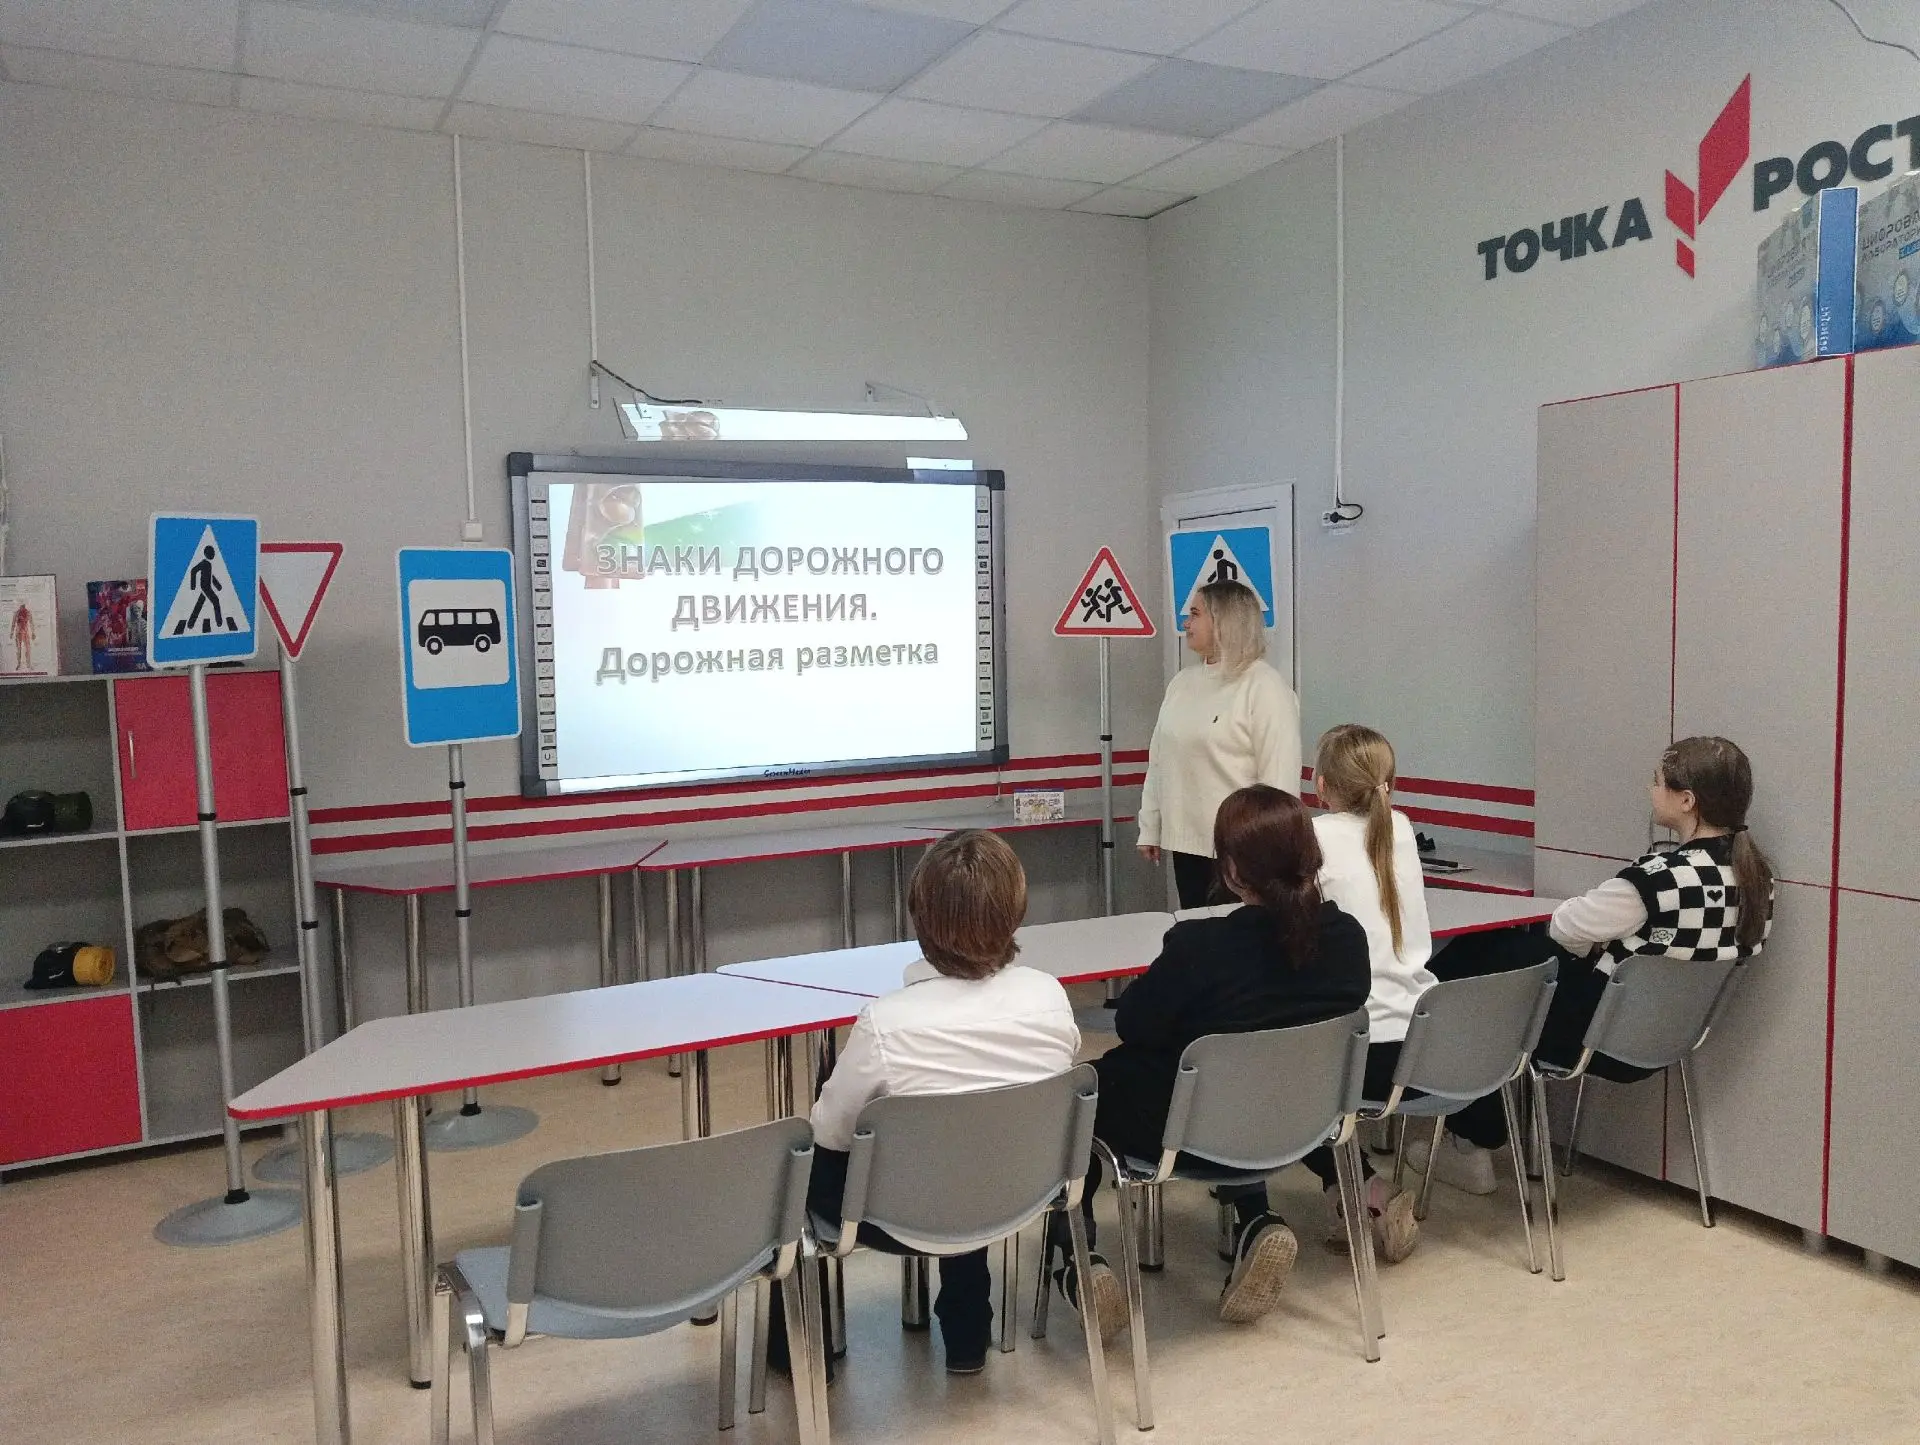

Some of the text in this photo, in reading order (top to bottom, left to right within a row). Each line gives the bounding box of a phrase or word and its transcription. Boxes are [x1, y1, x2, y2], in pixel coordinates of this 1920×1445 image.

[1477, 197, 1653, 280] ТОЧКА
[597, 544, 944, 582] ЗНАКИ ДОРОЖНОГО
[671, 592, 878, 631] ДВИЖЕНИЯ.
[596, 642, 939, 685] Дорожная разметка
